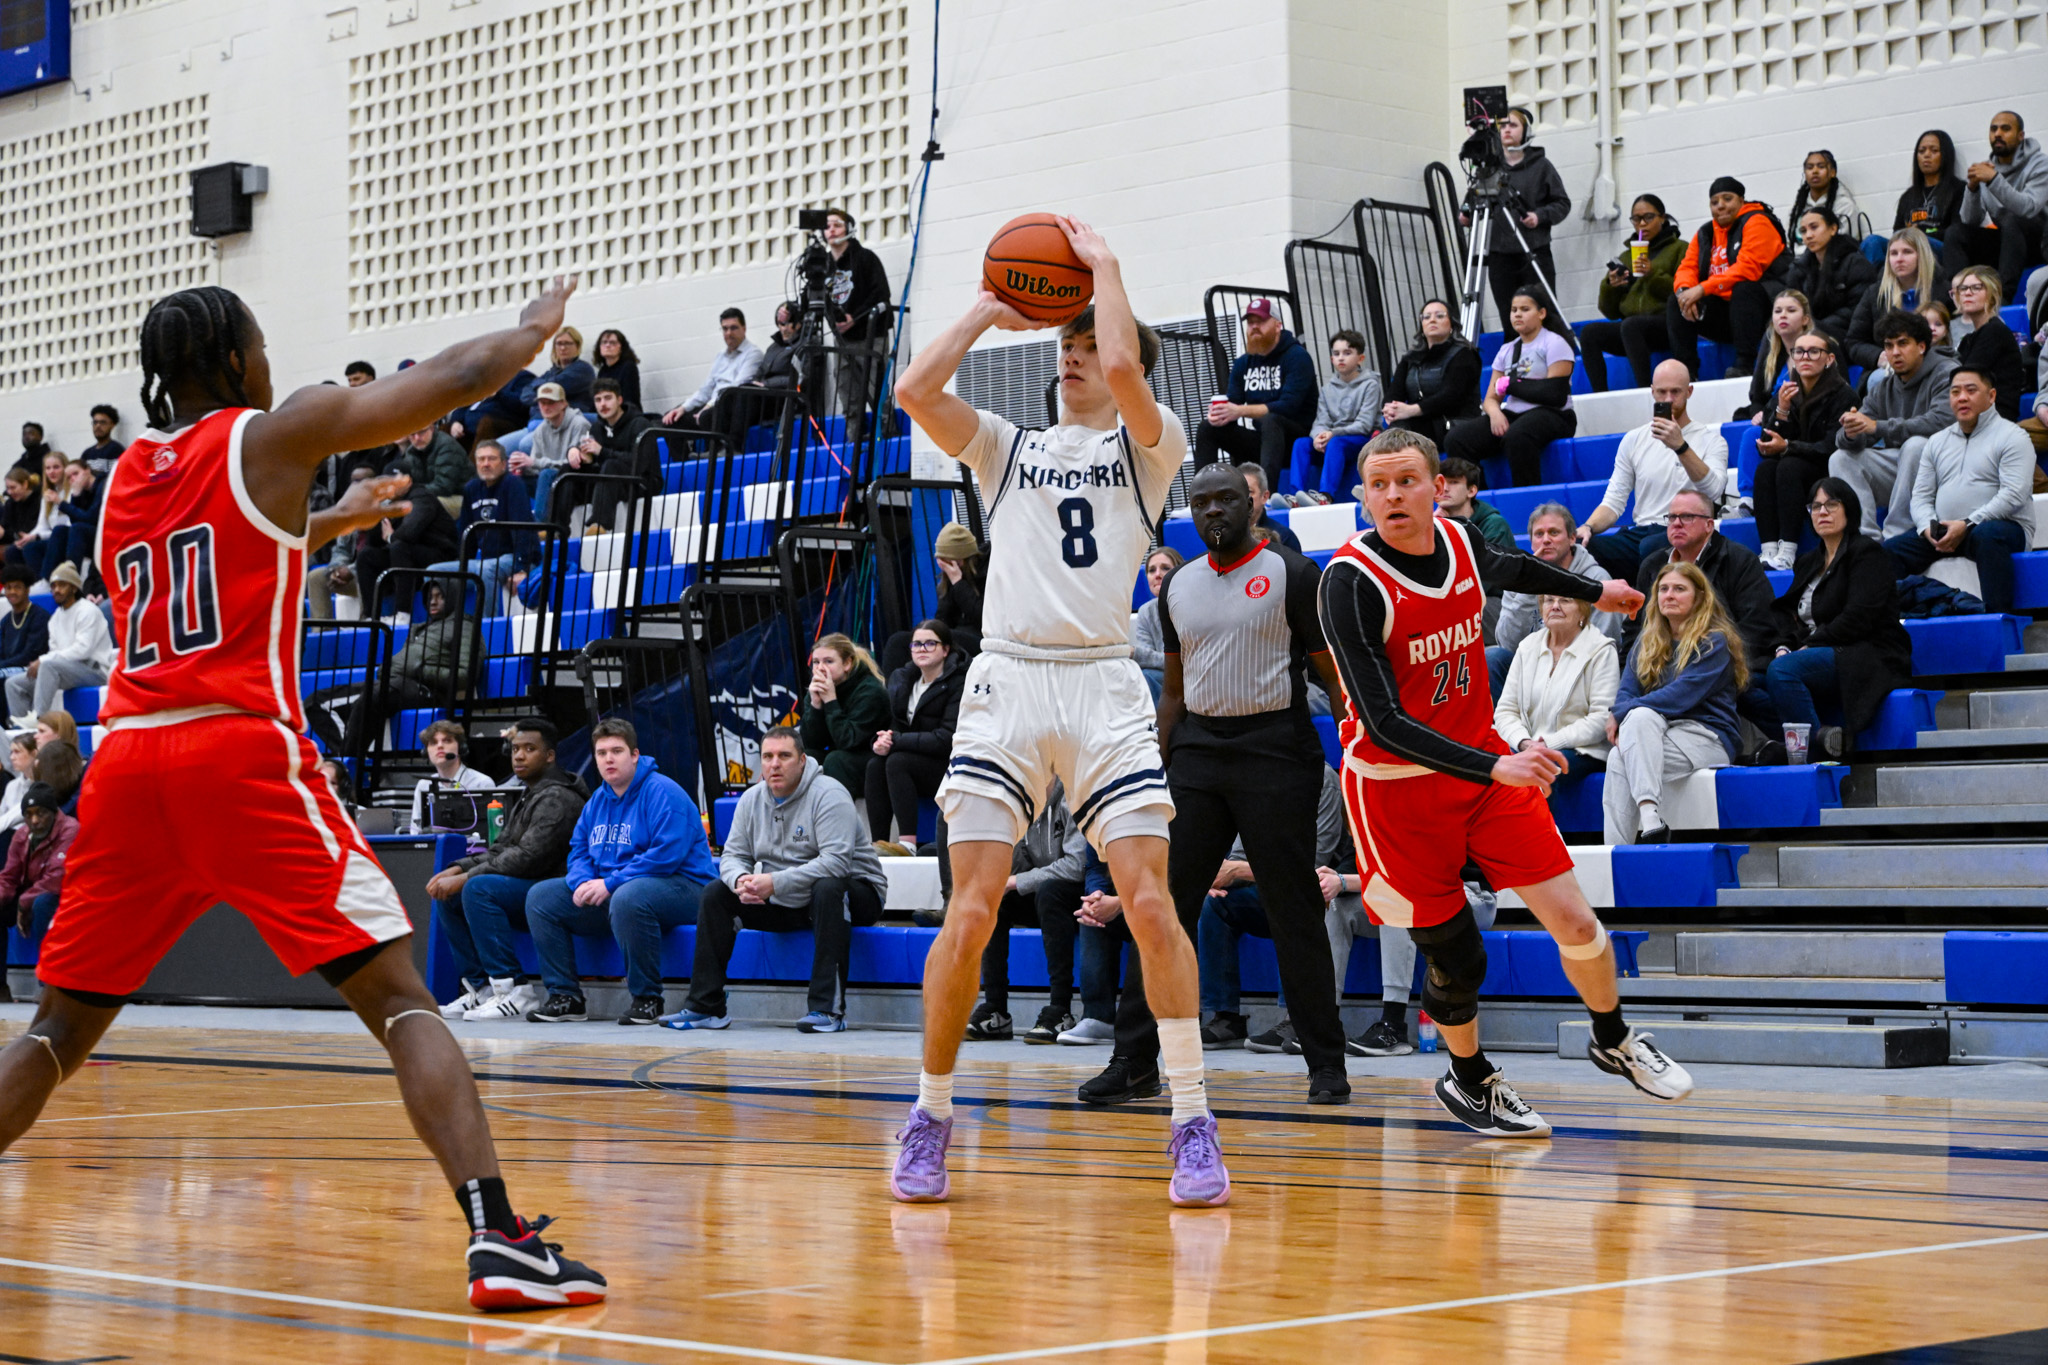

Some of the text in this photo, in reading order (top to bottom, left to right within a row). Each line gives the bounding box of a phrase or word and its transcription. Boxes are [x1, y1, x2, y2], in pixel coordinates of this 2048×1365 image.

[1006, 268, 1081, 298] Wilson
[1244, 377, 1282, 392] JONES
[1018, 459, 1129, 490] NIAGARA
[1057, 497, 1098, 568] 8
[114, 522, 223, 674] 20
[1408, 611, 1481, 665] ROYALS
[1431, 652, 1471, 706] 24
